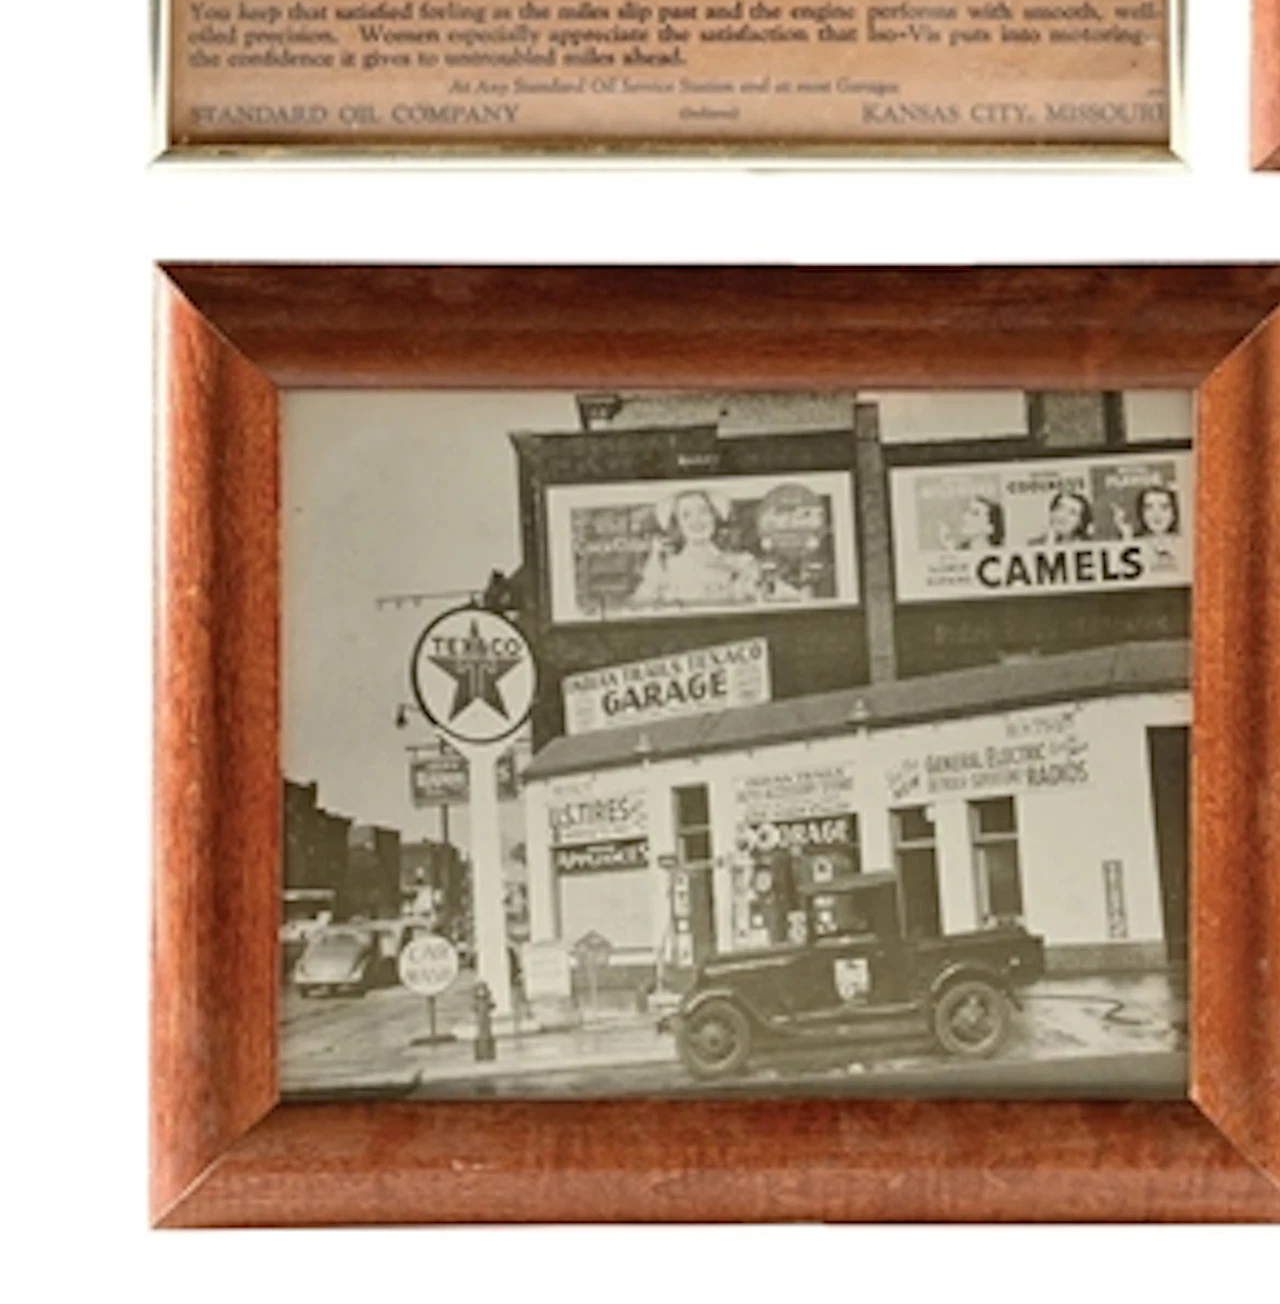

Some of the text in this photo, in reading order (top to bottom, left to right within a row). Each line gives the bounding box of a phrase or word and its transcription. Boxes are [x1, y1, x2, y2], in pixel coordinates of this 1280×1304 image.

[188, 105, 328, 125] STANDARD
[338, 105, 381, 125] OIL
[391, 105, 520, 125] COMPANY
[862, 102, 960, 124] KANSAS
[1045, 102, 1165, 124] MISSOURI
[976, 547, 1145, 588] CAMELS
[432, 637, 522, 656] TEXACO
[602, 670, 728, 716] GARAGE
